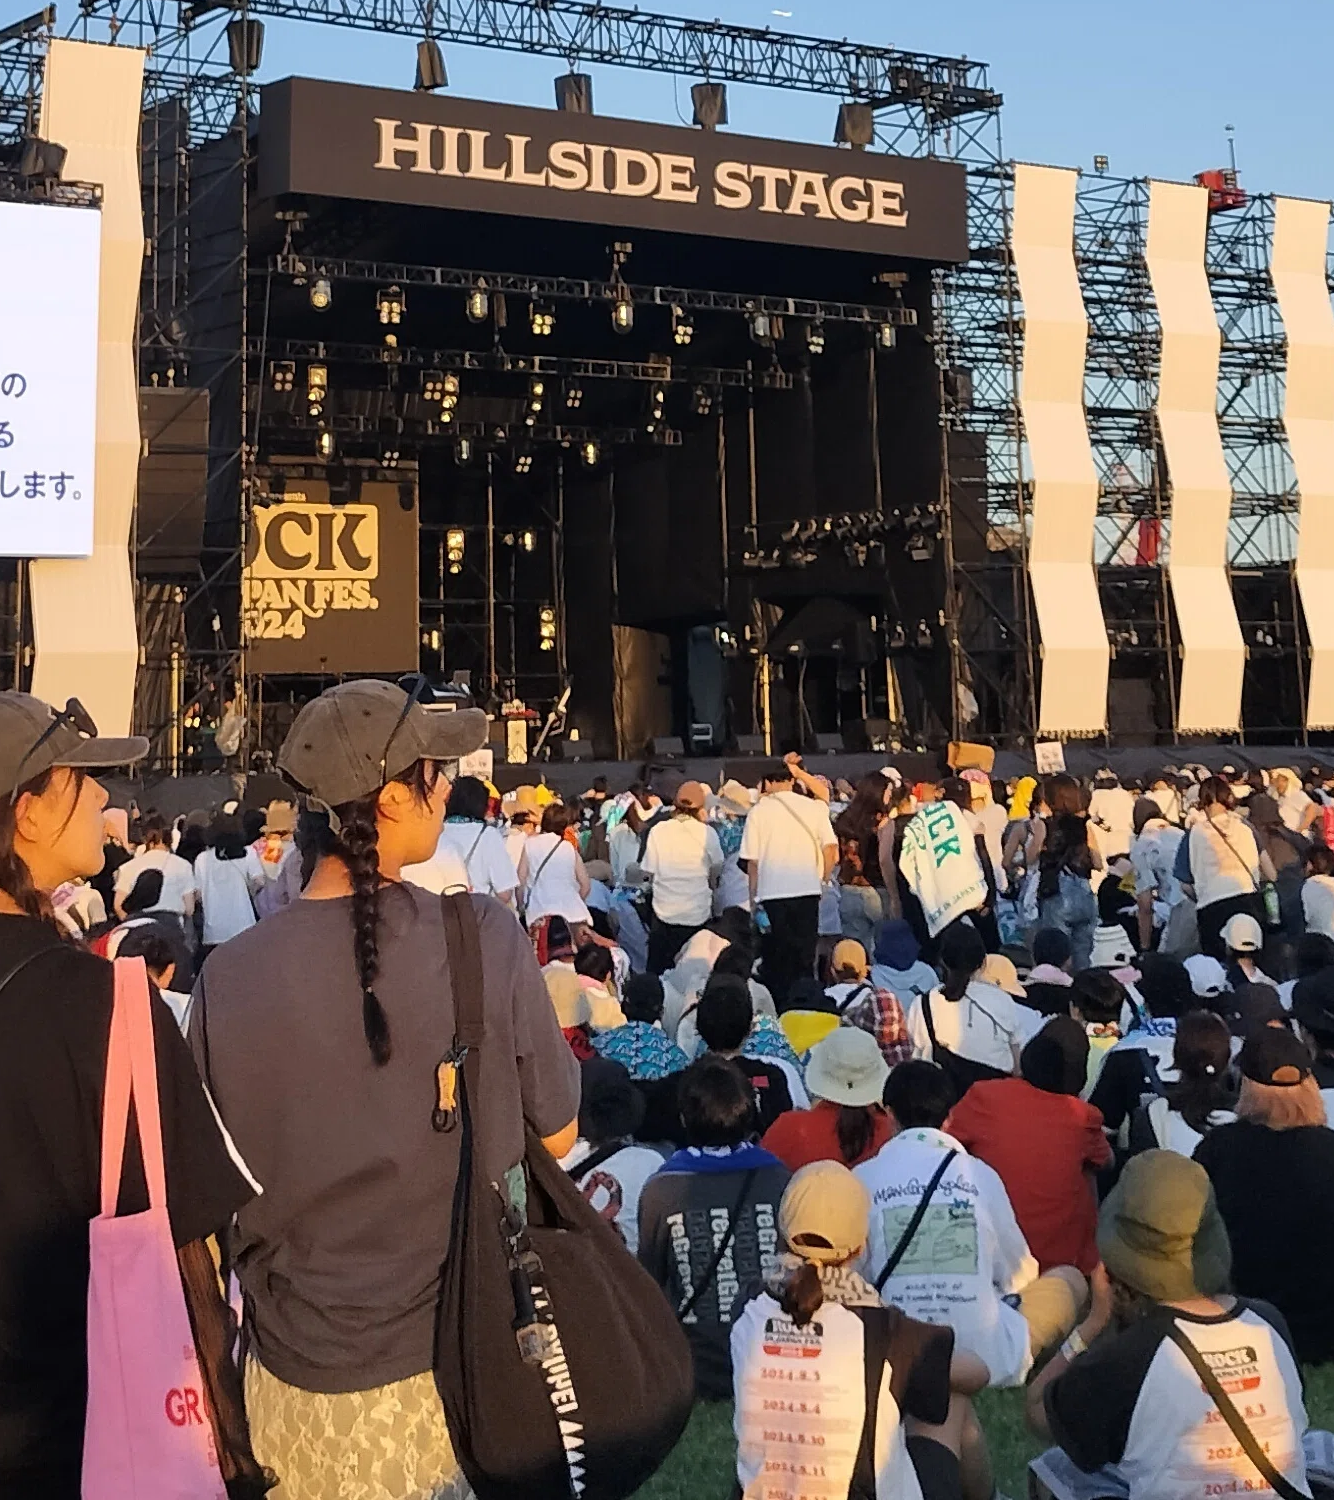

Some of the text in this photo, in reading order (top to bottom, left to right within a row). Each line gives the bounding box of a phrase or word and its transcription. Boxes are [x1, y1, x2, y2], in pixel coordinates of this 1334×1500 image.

[373, 117, 909, 228] HILLSIDE STAGE
[312, 580, 379, 610] FES.
